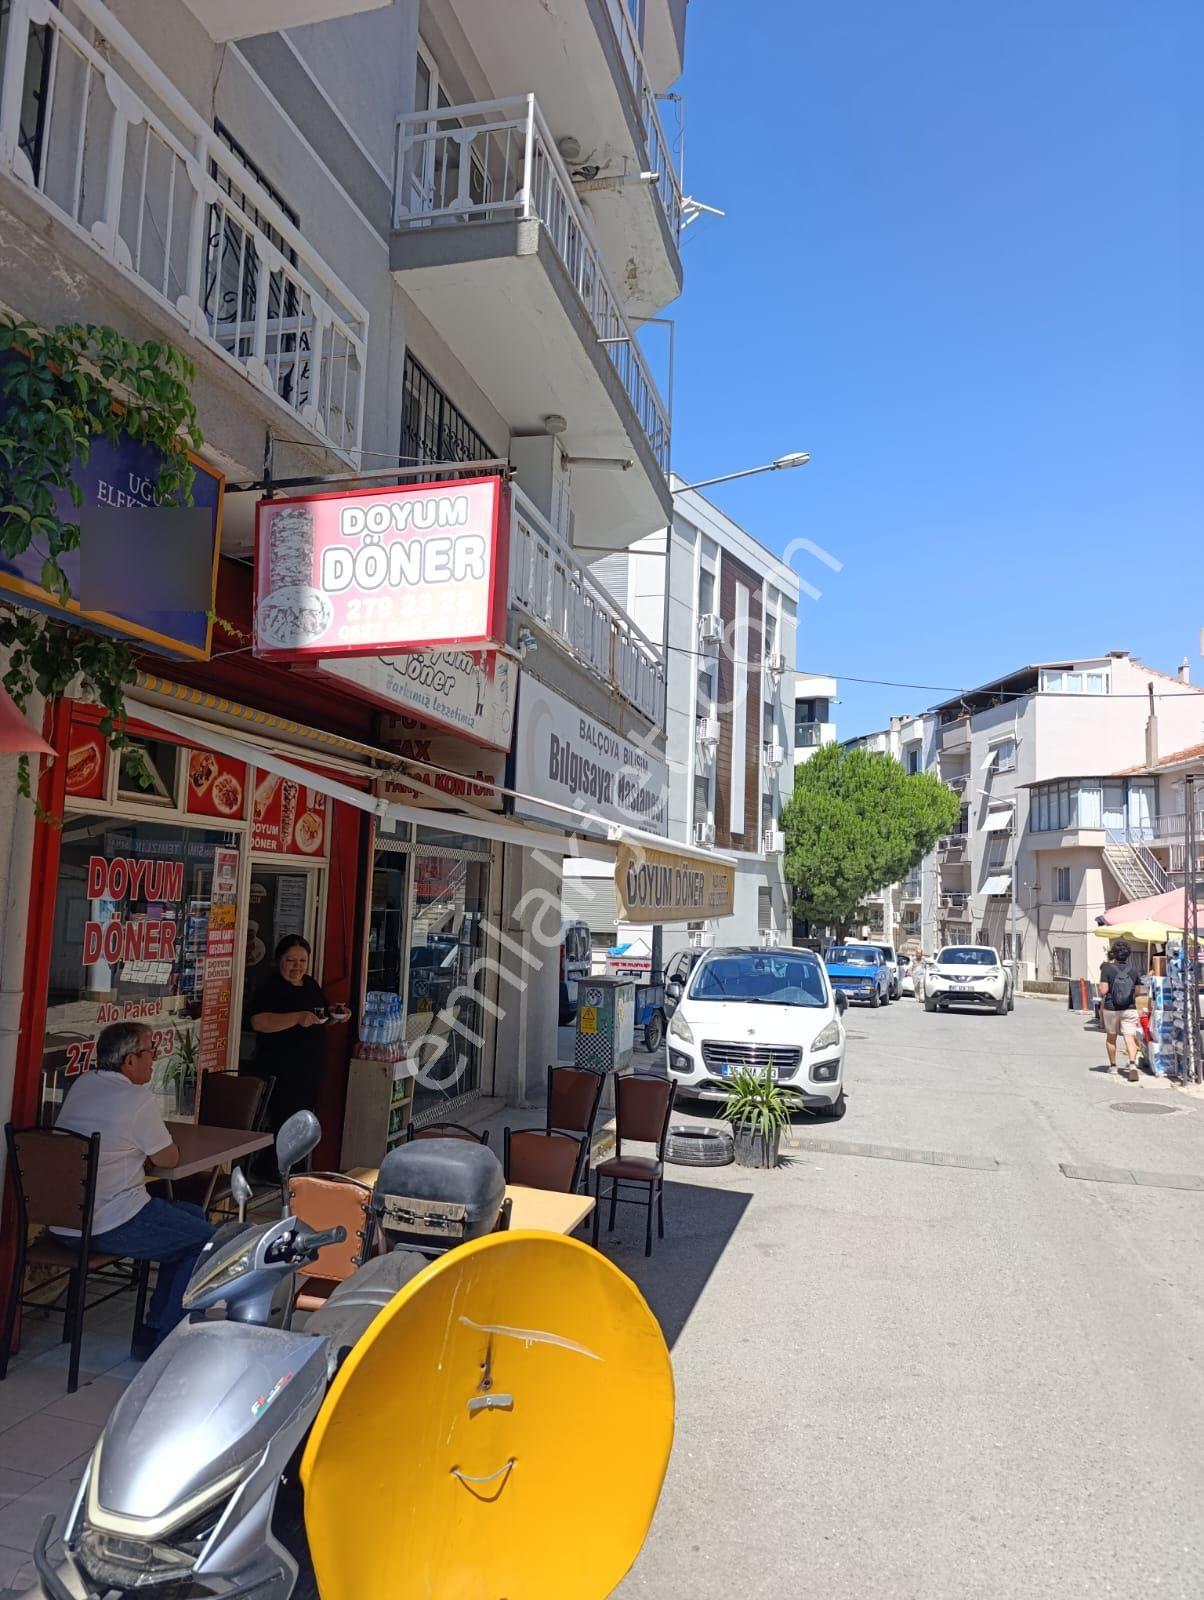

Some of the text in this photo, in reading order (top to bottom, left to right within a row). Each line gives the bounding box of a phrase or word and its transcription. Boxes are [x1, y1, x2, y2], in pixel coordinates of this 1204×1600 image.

[341, 495, 468, 537] DOYUM
[321, 533, 486, 593] DÖNER
[579, 718, 619, 761] BALÇOVA
[87, 855, 184, 902] DOYUM
[627, 860, 705, 907] DOYUM DÖNER
[82, 912, 177, 967] DÖNER
[96, 999, 161, 1023] Alo Paket
